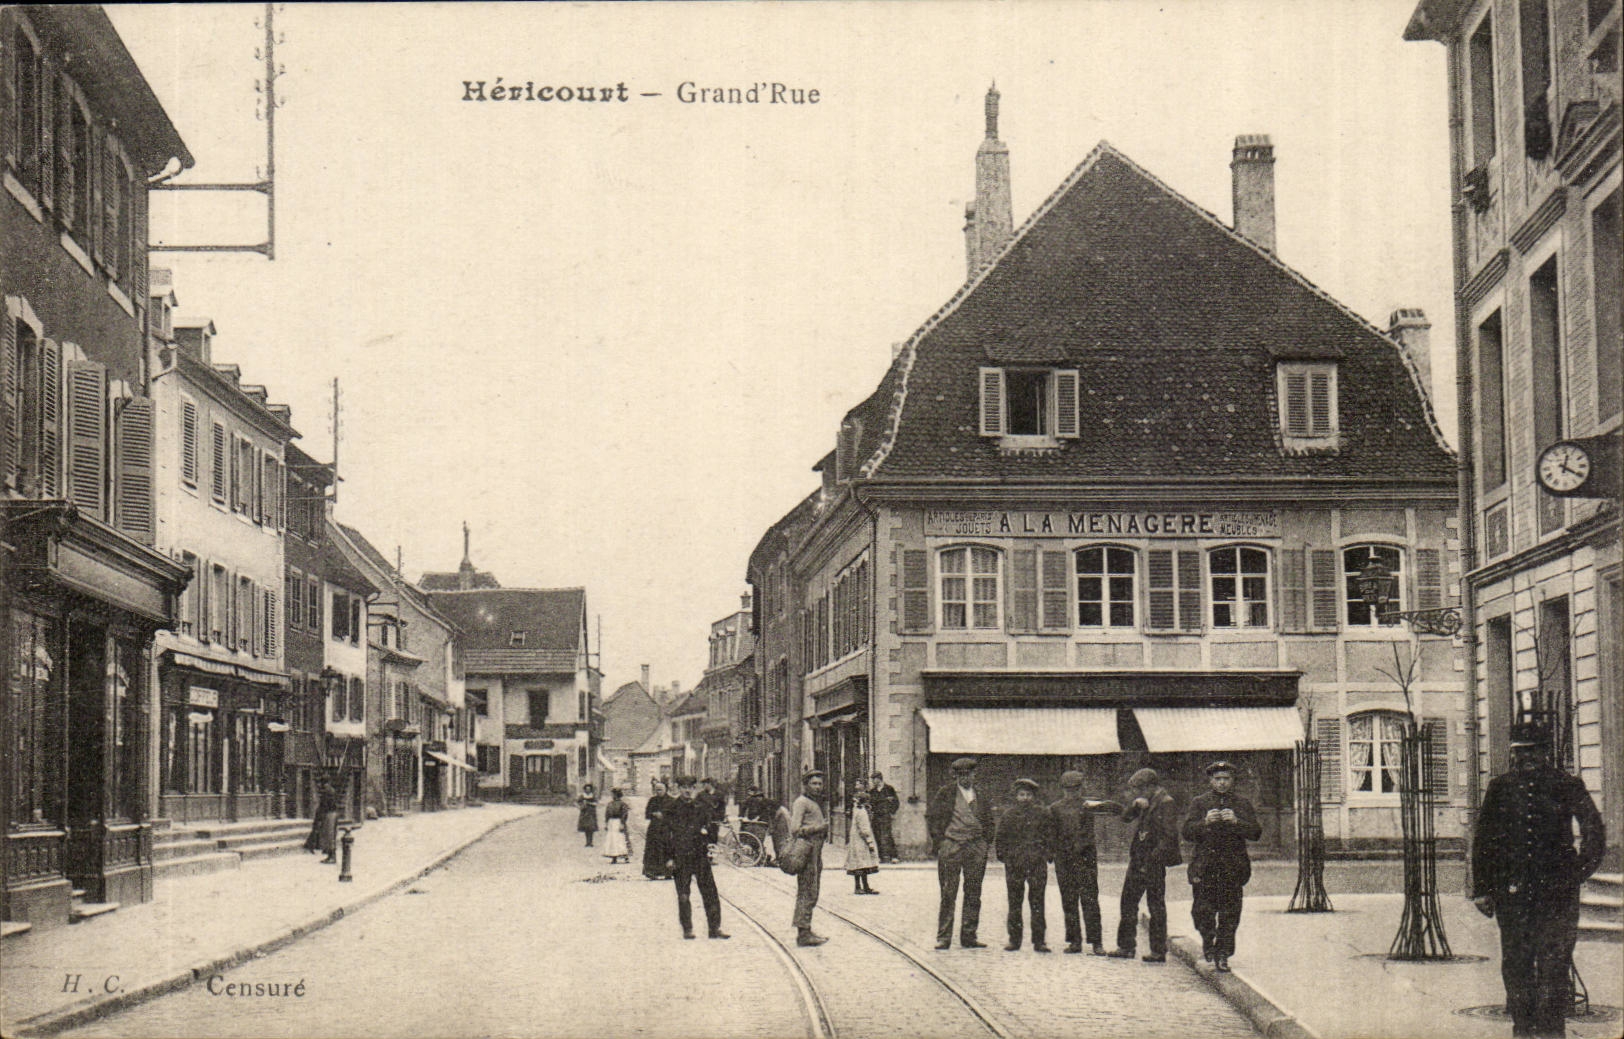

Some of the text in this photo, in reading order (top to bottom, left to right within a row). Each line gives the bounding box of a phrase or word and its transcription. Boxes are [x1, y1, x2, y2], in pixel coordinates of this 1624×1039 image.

[956, 523, 991, 534] JOUETS
[1000, 513, 1214, 534] A LA MENAGERE
